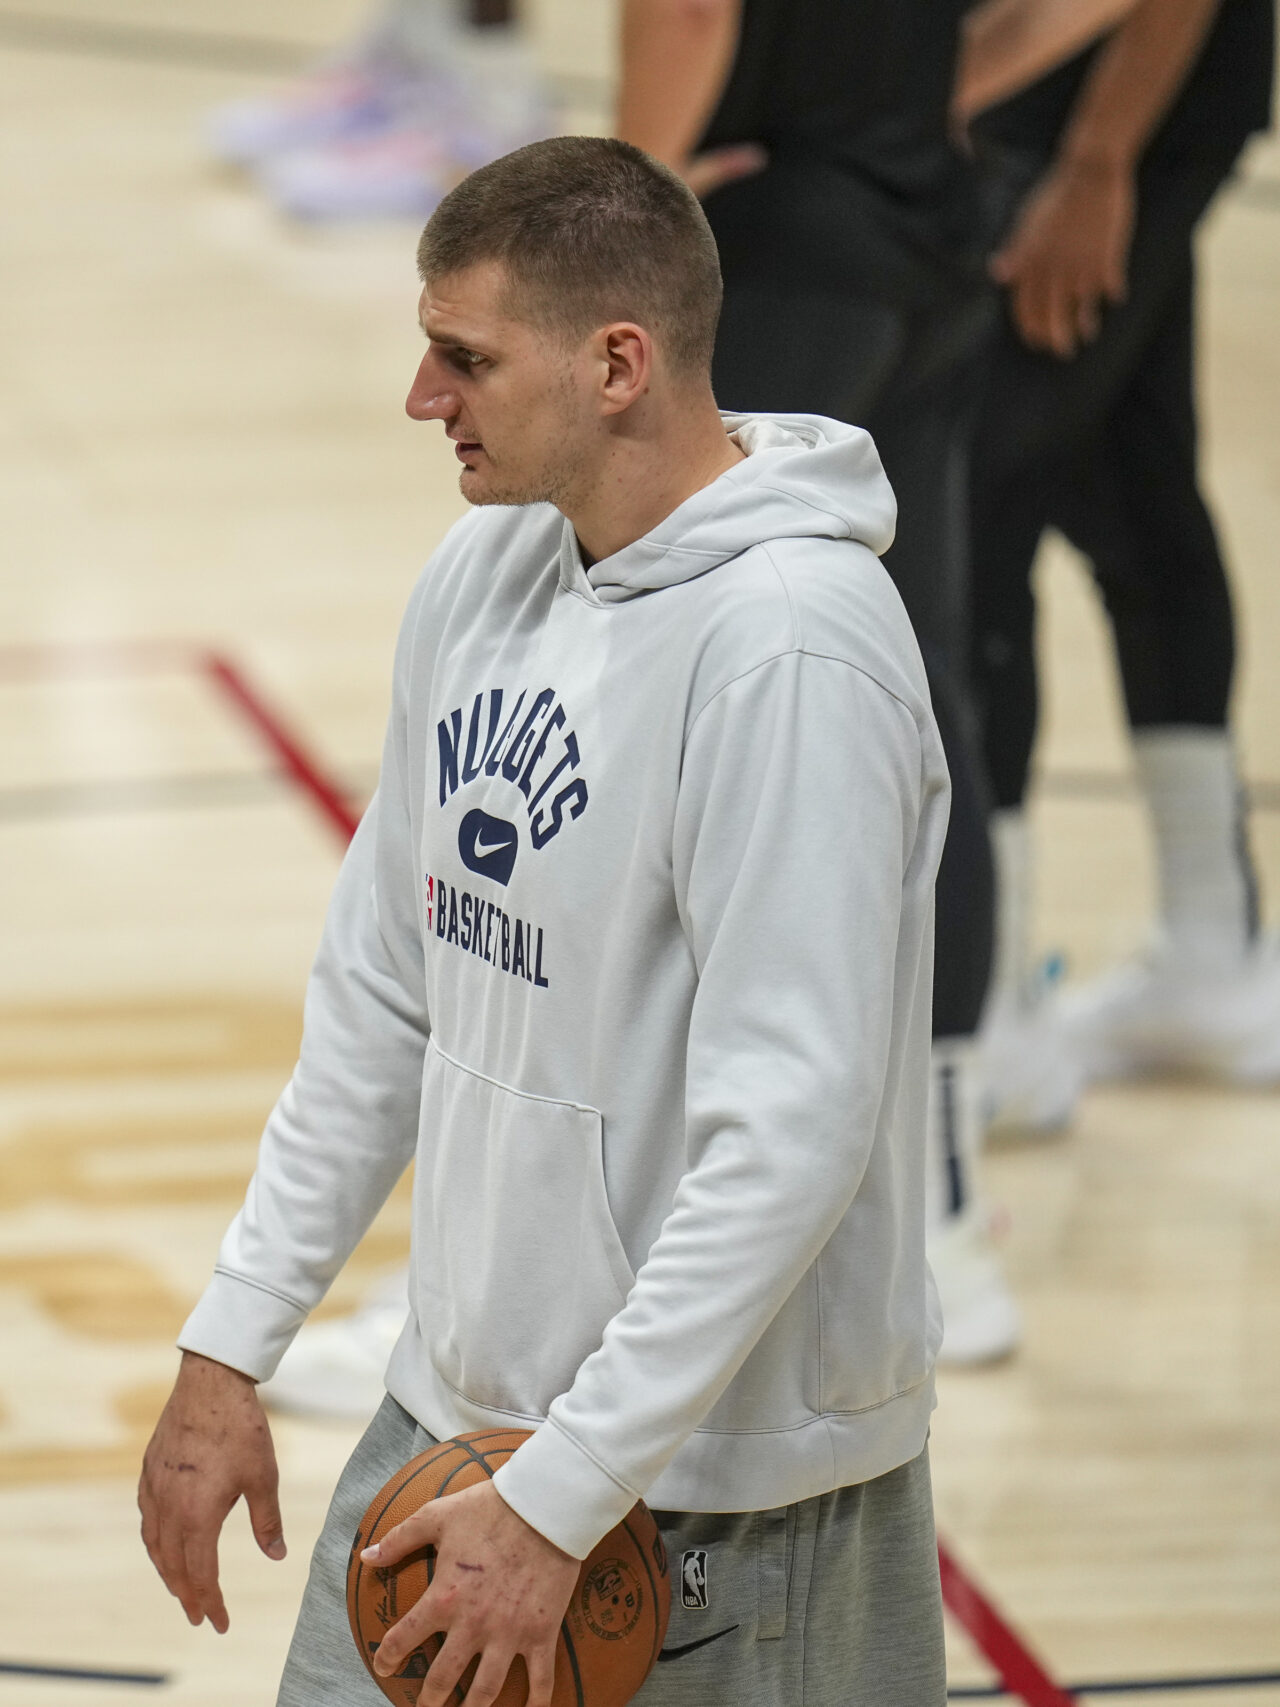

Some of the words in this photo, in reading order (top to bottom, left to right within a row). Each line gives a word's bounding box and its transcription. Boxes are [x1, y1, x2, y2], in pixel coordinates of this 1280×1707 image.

[437, 687, 589, 850] NUGGETS
[437, 878, 549, 988] BASKETBALL
[685, 1595, 699, 1606] NBA
